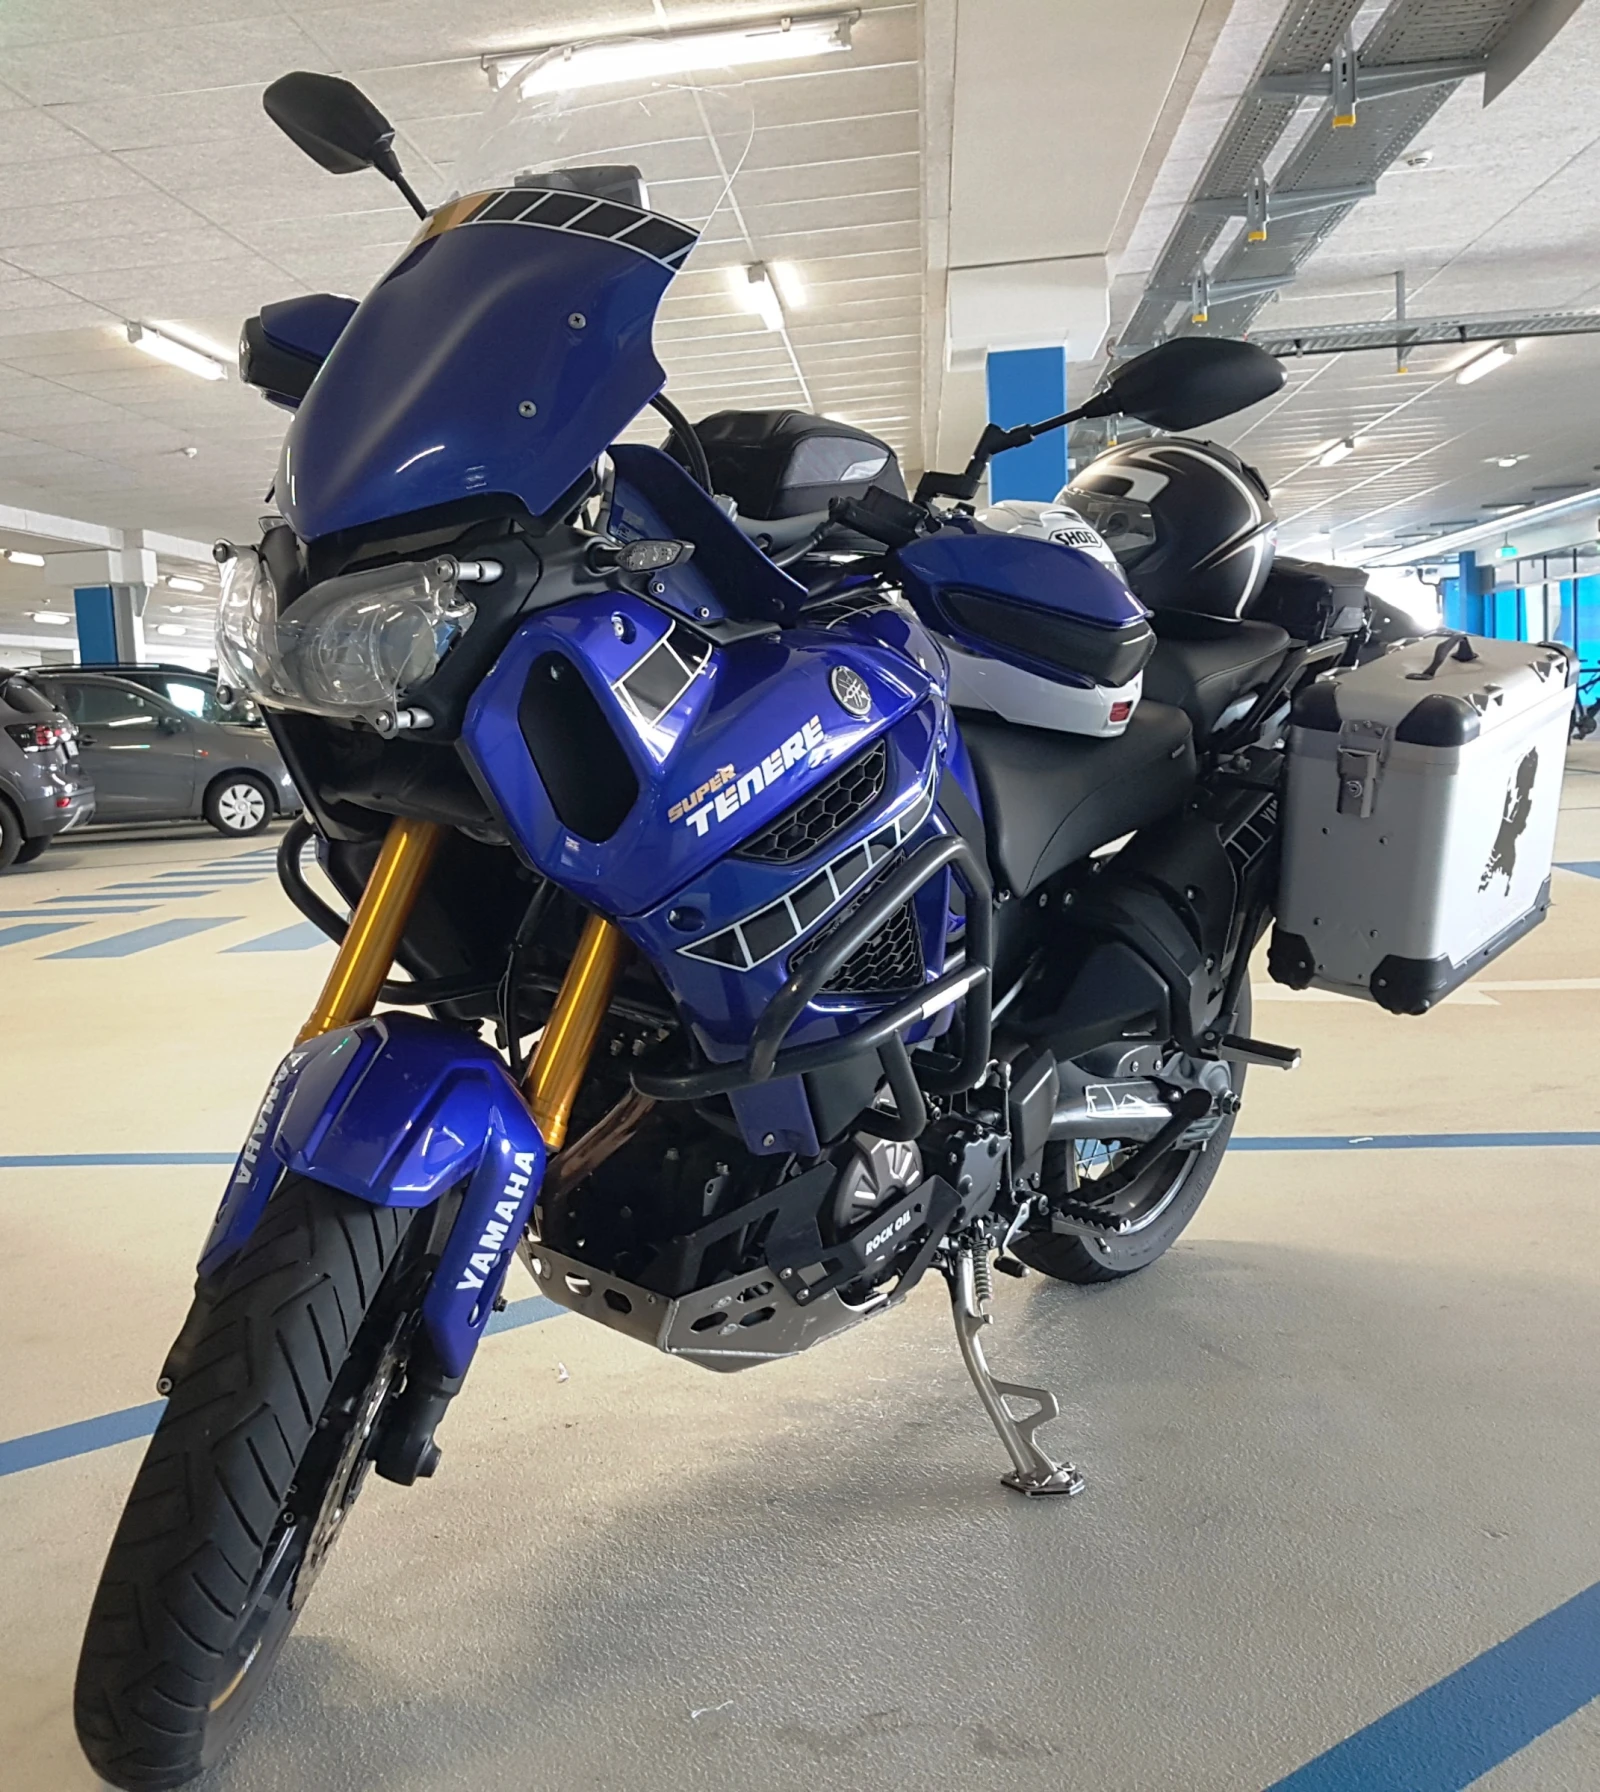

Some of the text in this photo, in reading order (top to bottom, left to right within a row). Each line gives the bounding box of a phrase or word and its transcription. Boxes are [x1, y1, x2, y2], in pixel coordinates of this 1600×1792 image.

[667, 763, 736, 823] SUPER
[235, 1052, 309, 1184] YAMAHA
[456, 1152, 534, 1290] YAMAHA
[865, 1223, 893, 1255] ROCK
